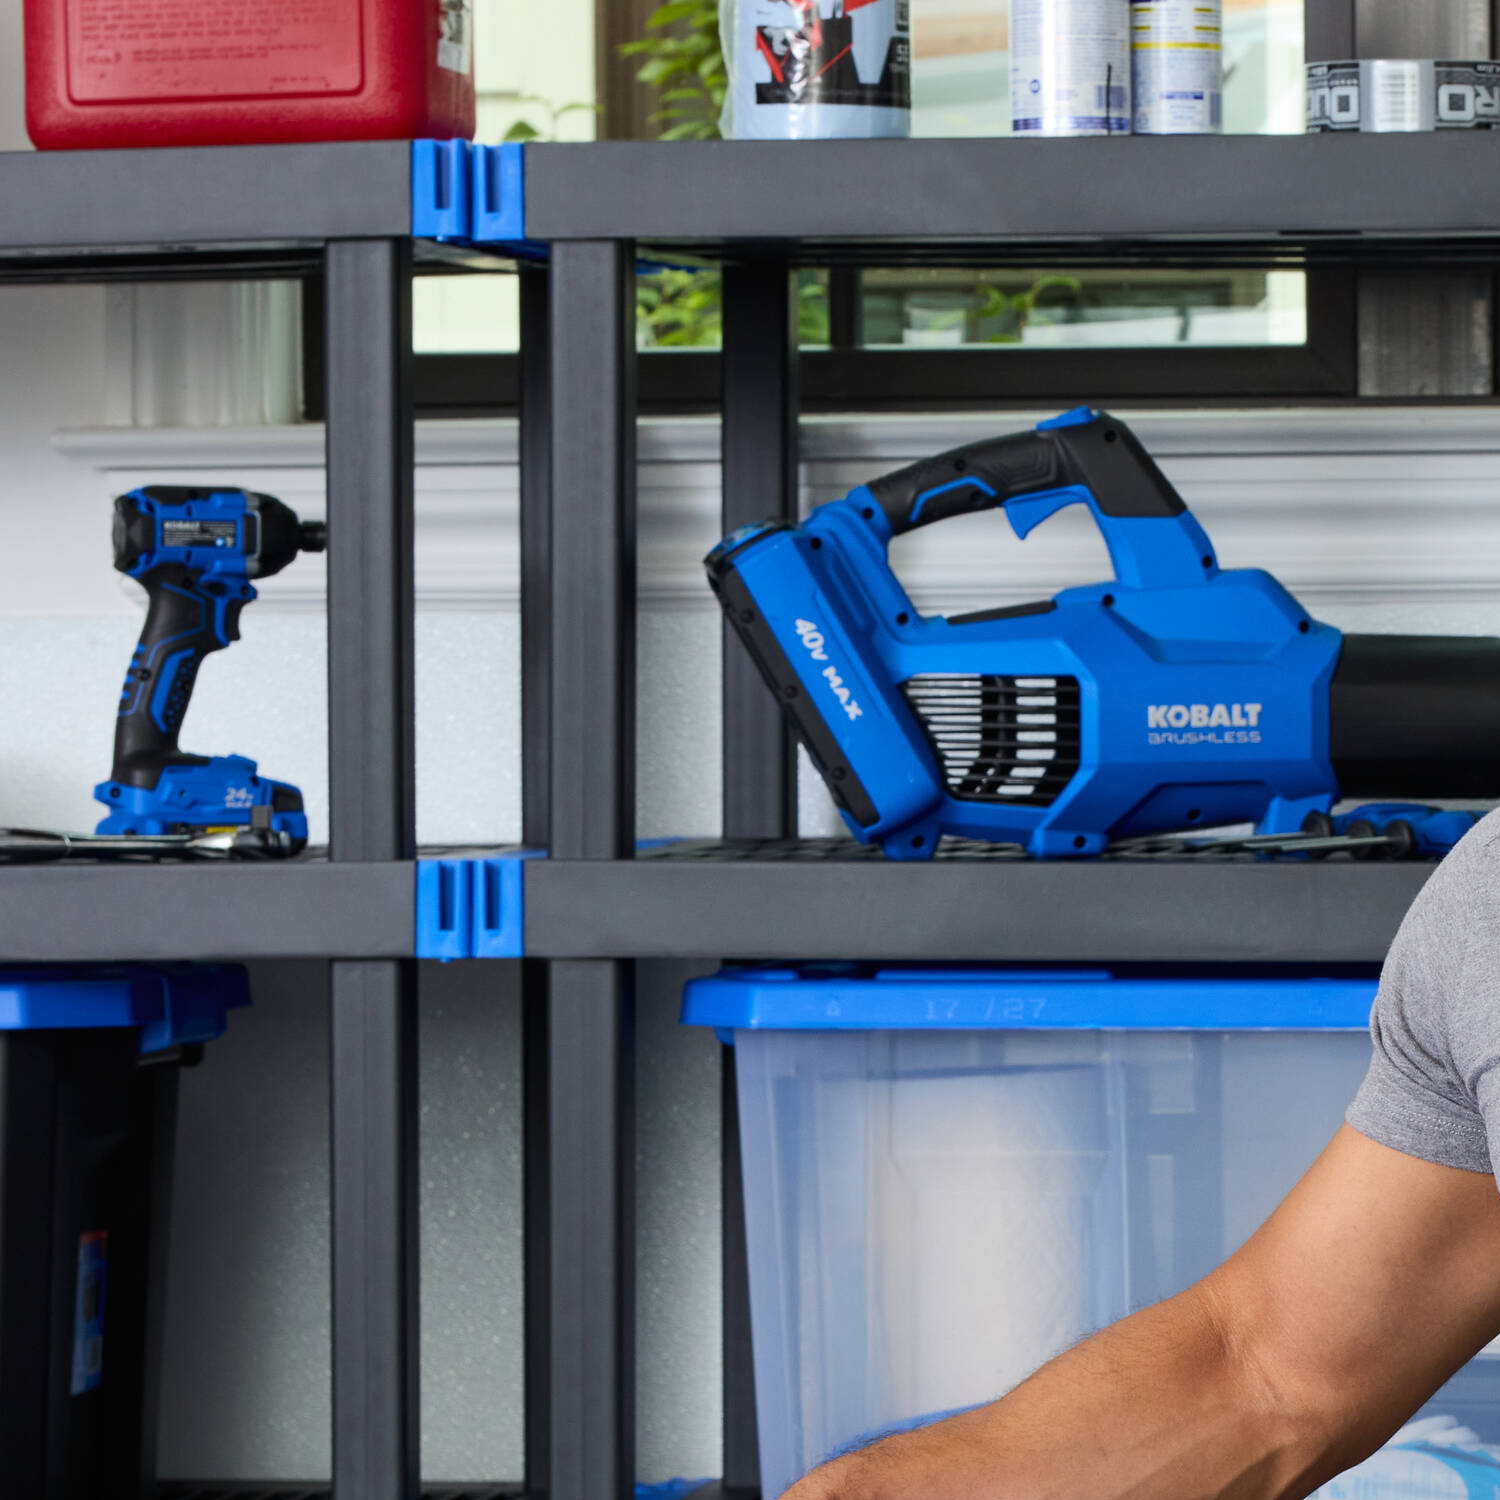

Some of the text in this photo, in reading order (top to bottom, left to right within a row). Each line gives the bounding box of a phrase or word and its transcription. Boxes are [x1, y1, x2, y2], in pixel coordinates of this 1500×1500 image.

[822, 665, 863, 721] MAX
[1147, 703, 1262, 728] KOBALT
[1148, 730, 1262, 745] BRUSHLESS
